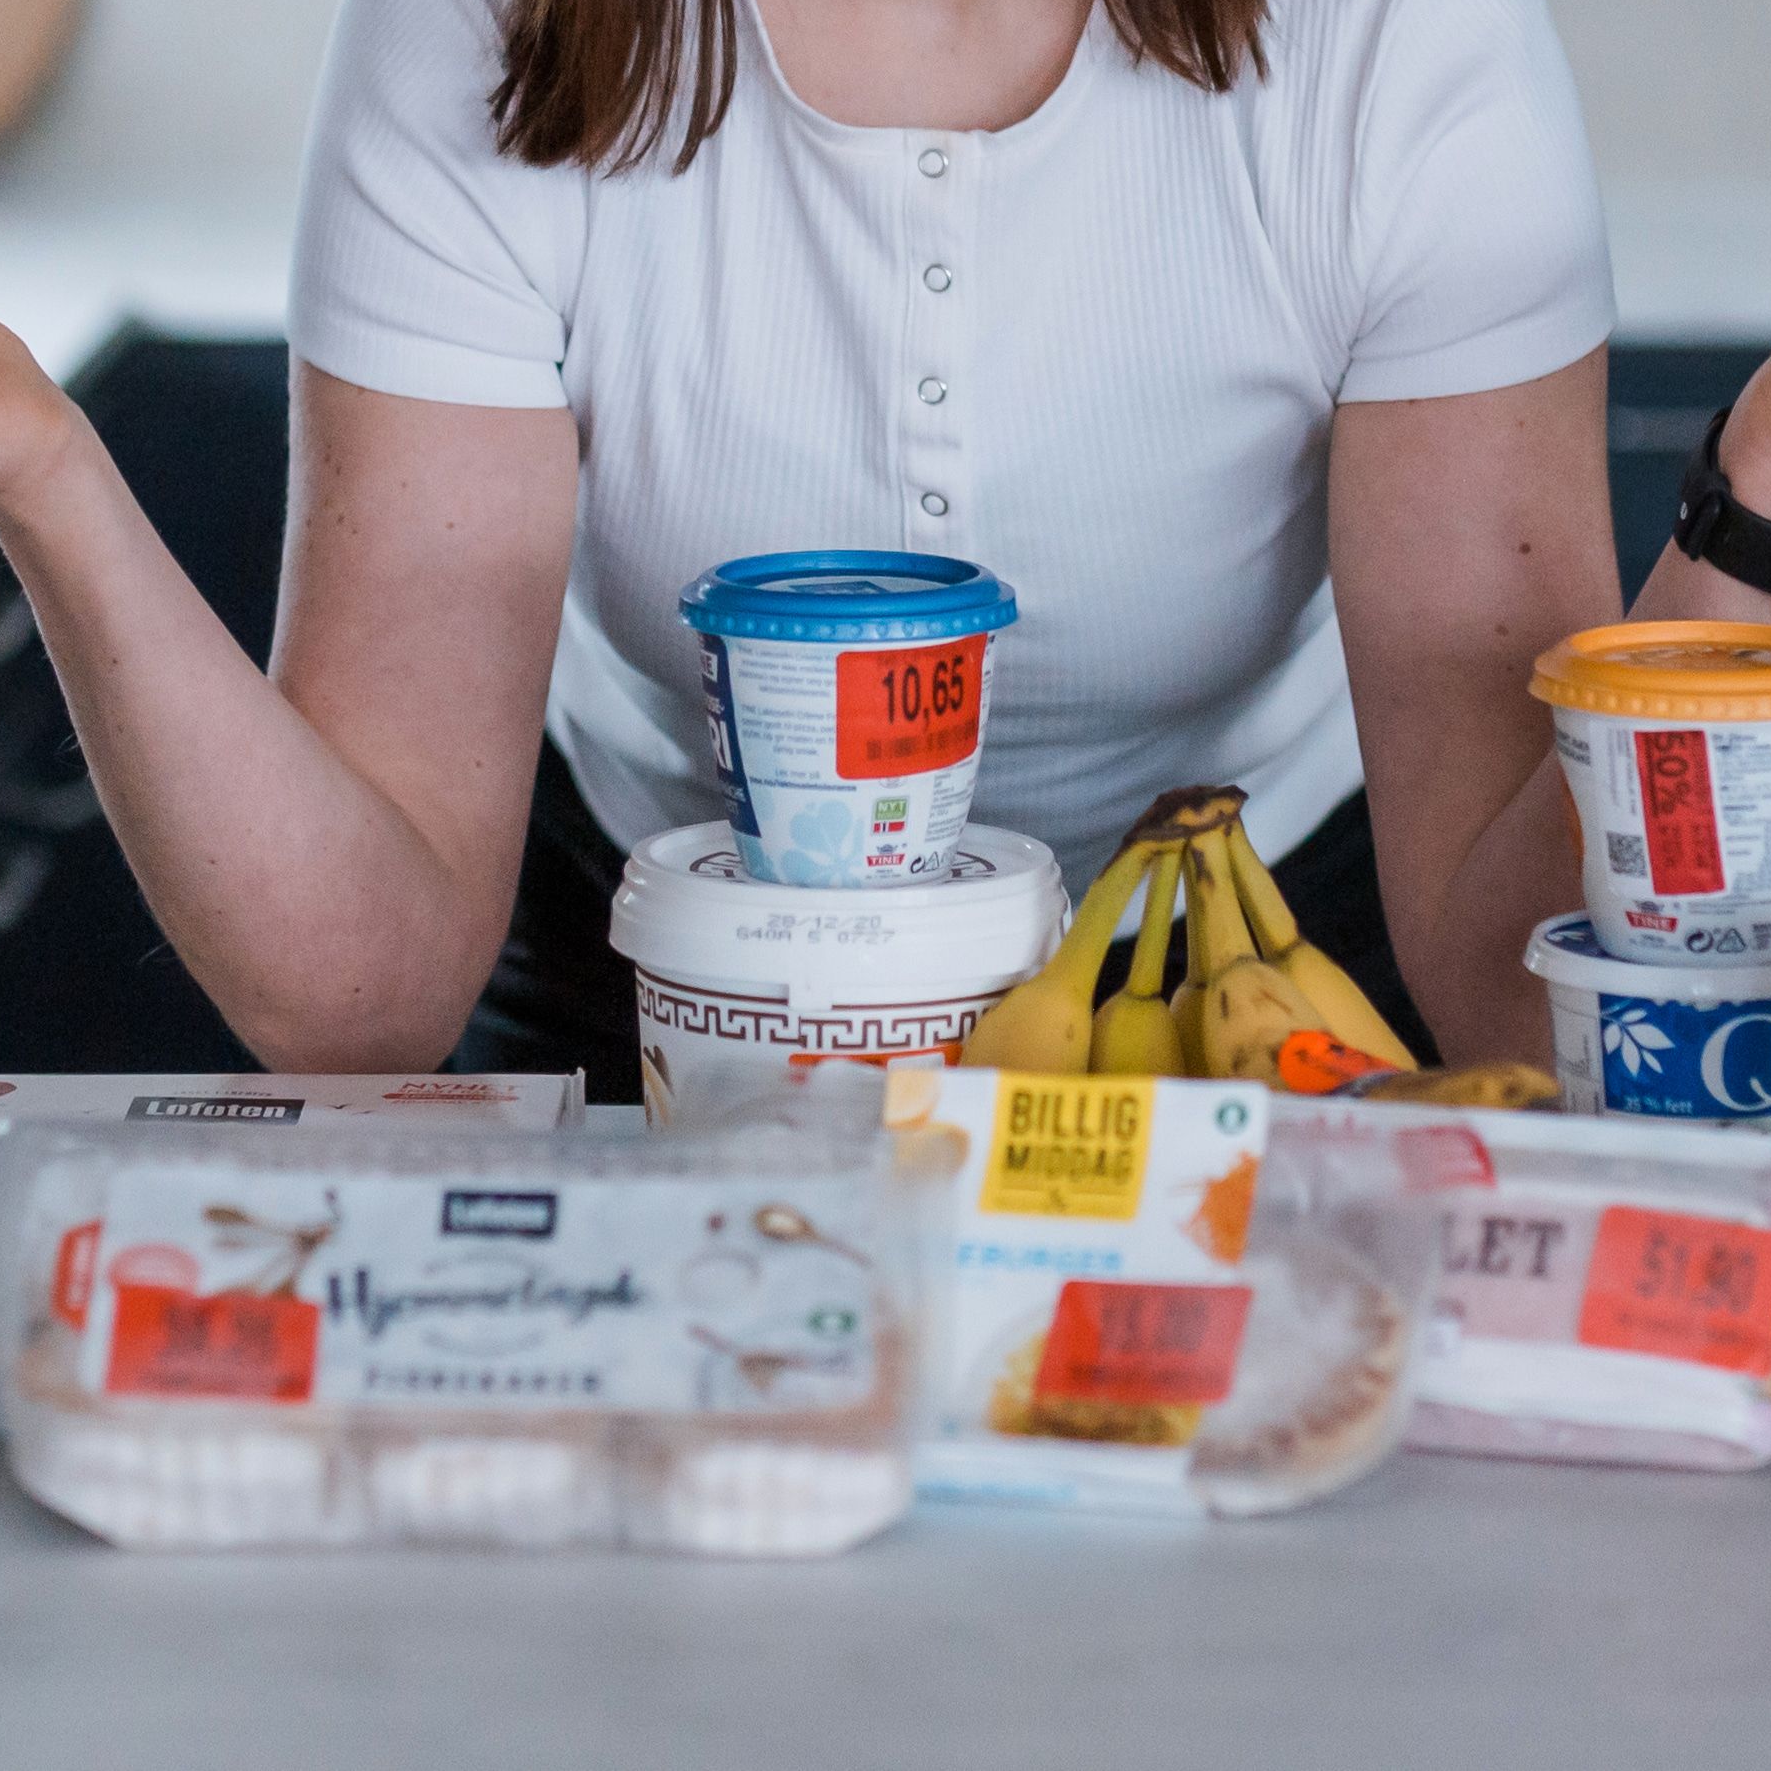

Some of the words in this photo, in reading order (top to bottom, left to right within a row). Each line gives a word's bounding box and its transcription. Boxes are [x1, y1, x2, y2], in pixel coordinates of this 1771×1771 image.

[882, 655, 964, 728] 10,65
[870, 855, 901, 866] TINE
[767, 913, 881, 930] 28/12/20
[145, 1100, 287, 1119] Lofoten
[1009, 1091, 1140, 1143] BILLIG
